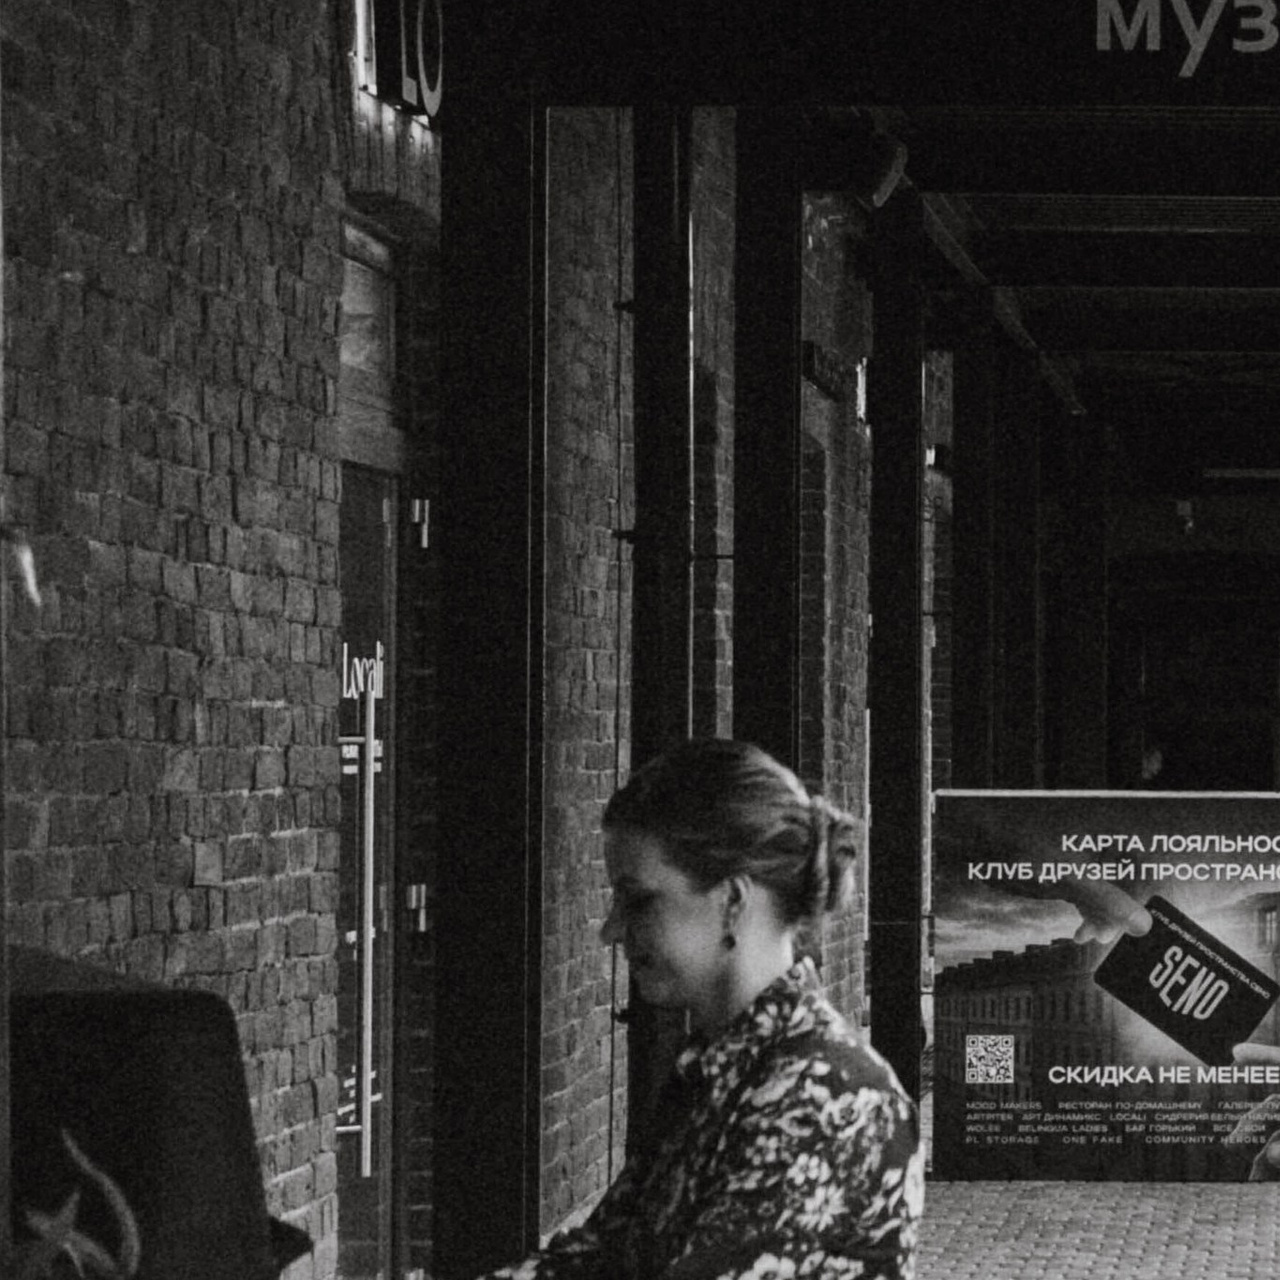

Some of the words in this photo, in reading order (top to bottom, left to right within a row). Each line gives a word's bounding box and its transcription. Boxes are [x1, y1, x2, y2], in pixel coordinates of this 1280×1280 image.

[1061, 834, 1144, 853] КАРТА
[967, 862, 1034, 881] КЛУБ
[1038, 858, 1135, 885] ДРУЗЕЙ
[1149, 945, 1230, 1020] SENO
[1048, 1065, 1154, 1087] СКИДКА
[1158, 1065, 1191, 1085] НЕ
[1197, 1065, 1280, 1085] МЕНЕЕ
[1058, 1102, 1112, 1111] РЕСТОРАН
[1144, 1136, 1214, 1145] COMMUNITY
